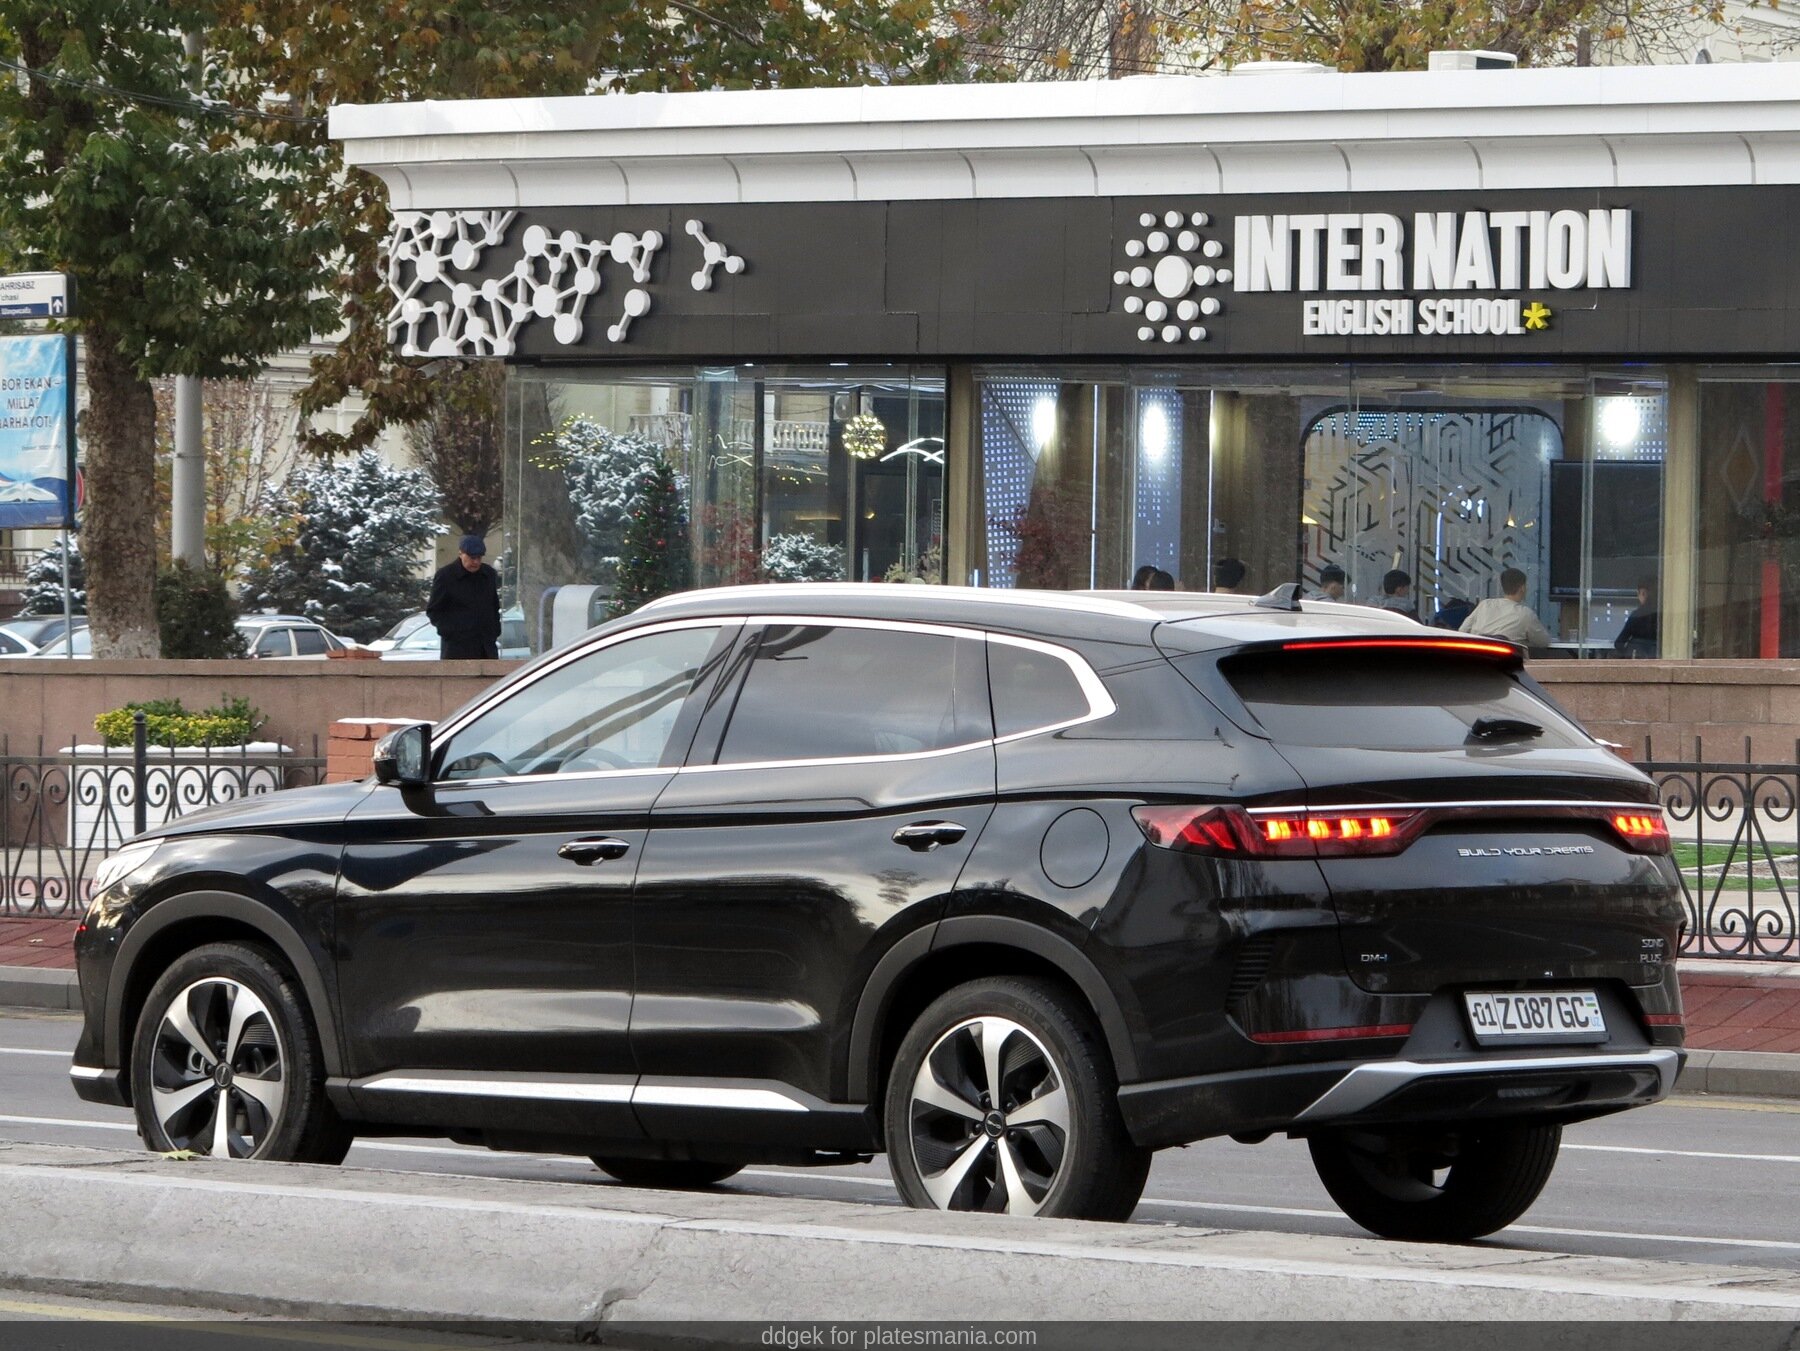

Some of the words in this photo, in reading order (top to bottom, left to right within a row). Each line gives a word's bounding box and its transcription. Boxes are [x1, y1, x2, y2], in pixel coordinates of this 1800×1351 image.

[1233, 213, 1404, 292] INTER
[1413, 209, 1632, 290] NATION
[1303, 300, 1413, 336] ENGLISH
[2, 379, 21, 390] BOR
[24, 377, 52, 390] EKAN
[1457, 848, 1501, 857] BUILD
[1503, 847, 1541, 856] YOUR
[1543, 845, 1594, 855] DREAMS
[1641, 938, 1664, 948] SONG
[1640, 953, 1662, 963] PLUS
